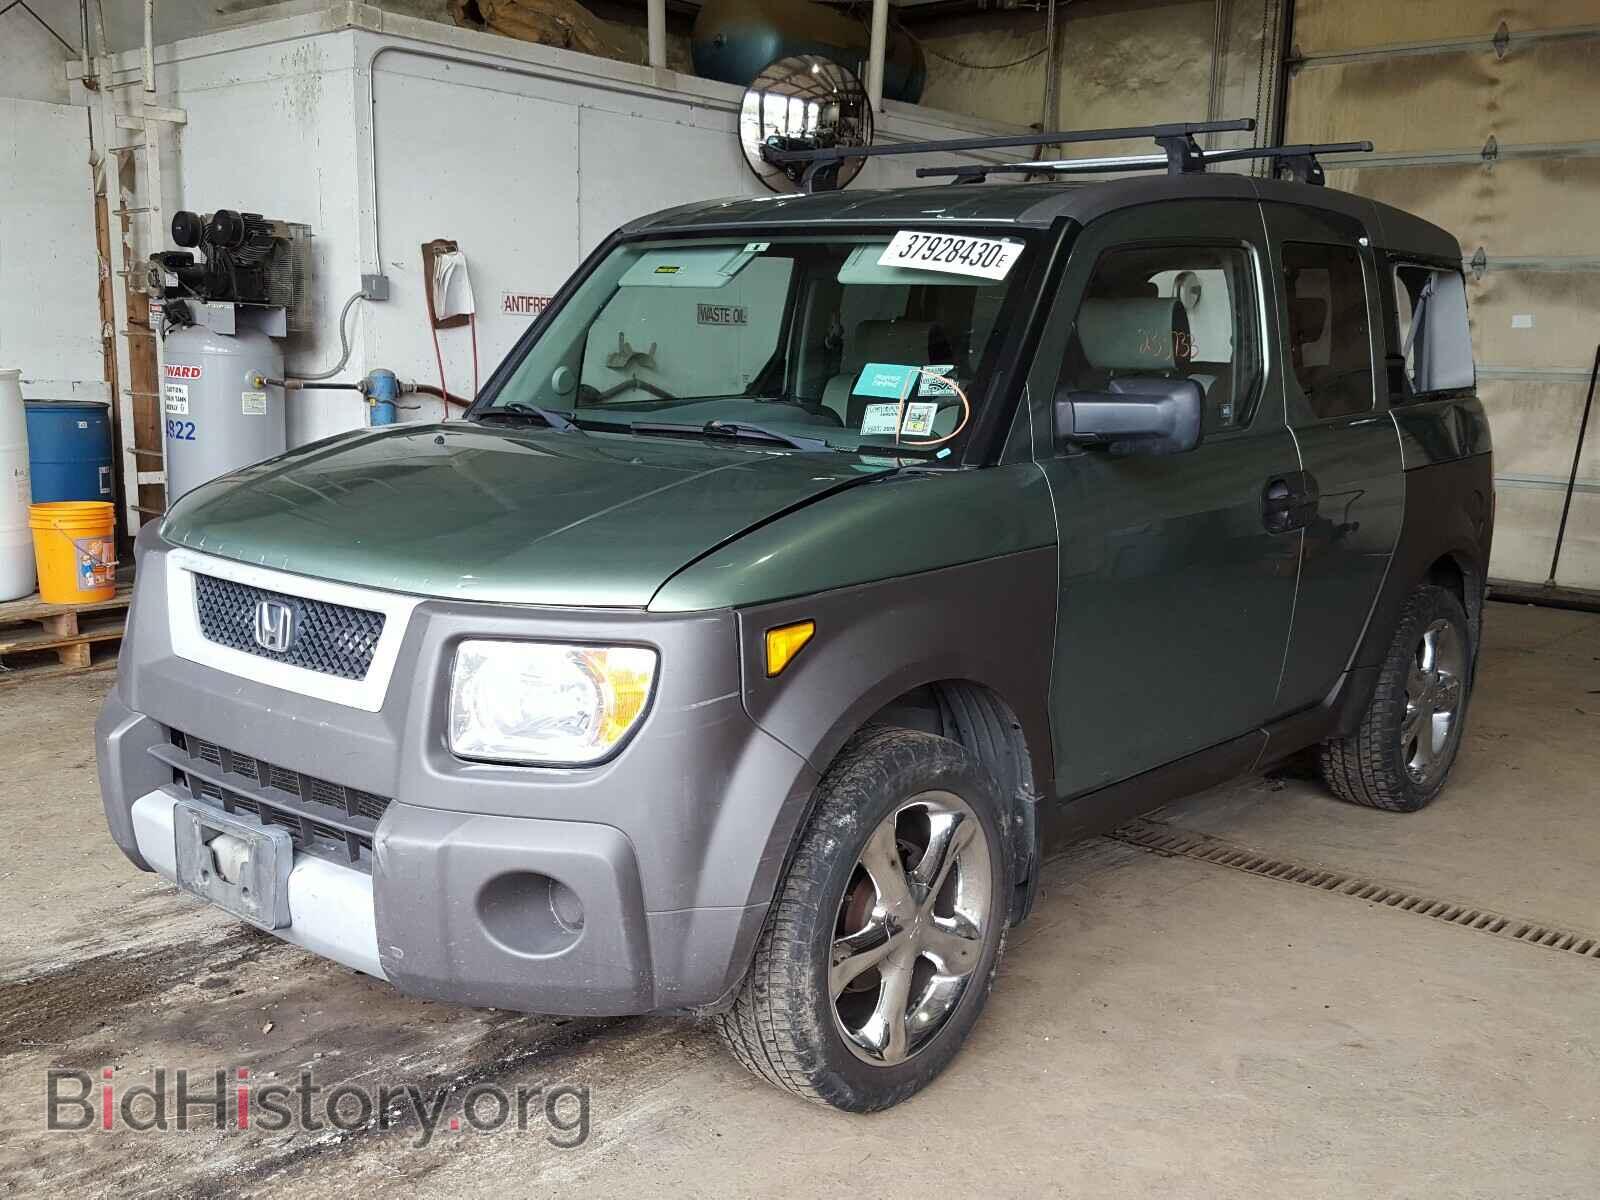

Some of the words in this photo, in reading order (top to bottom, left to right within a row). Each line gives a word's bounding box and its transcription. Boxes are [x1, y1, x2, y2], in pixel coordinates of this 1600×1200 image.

[699, 306, 730, 322] WASTE
[732, 308, 747, 323] OIL
[164, 365, 201, 378] WARD
